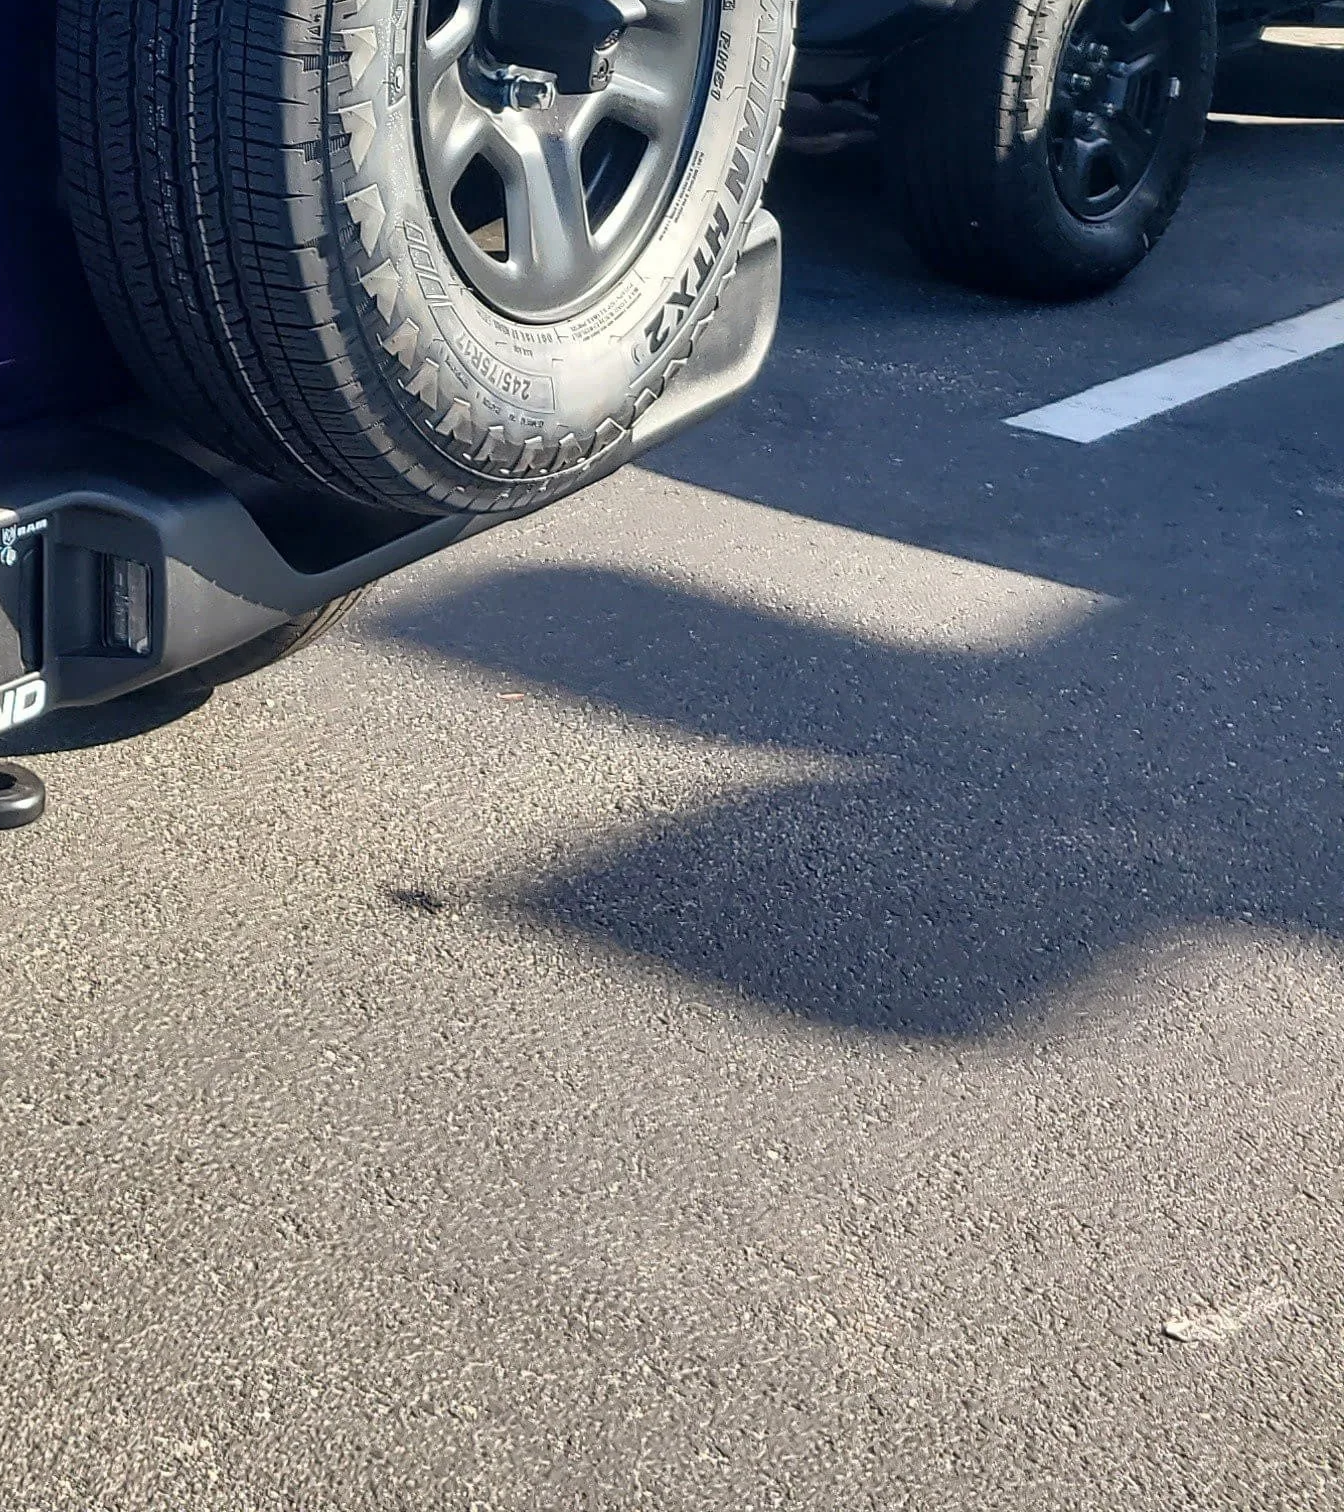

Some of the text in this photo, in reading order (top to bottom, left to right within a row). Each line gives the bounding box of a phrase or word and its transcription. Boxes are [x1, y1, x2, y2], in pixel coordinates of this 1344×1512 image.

[643, 205, 731, 354] HTX2
[454, 331, 534, 401] 245/75R17
[16, 519, 48, 537] RAM
